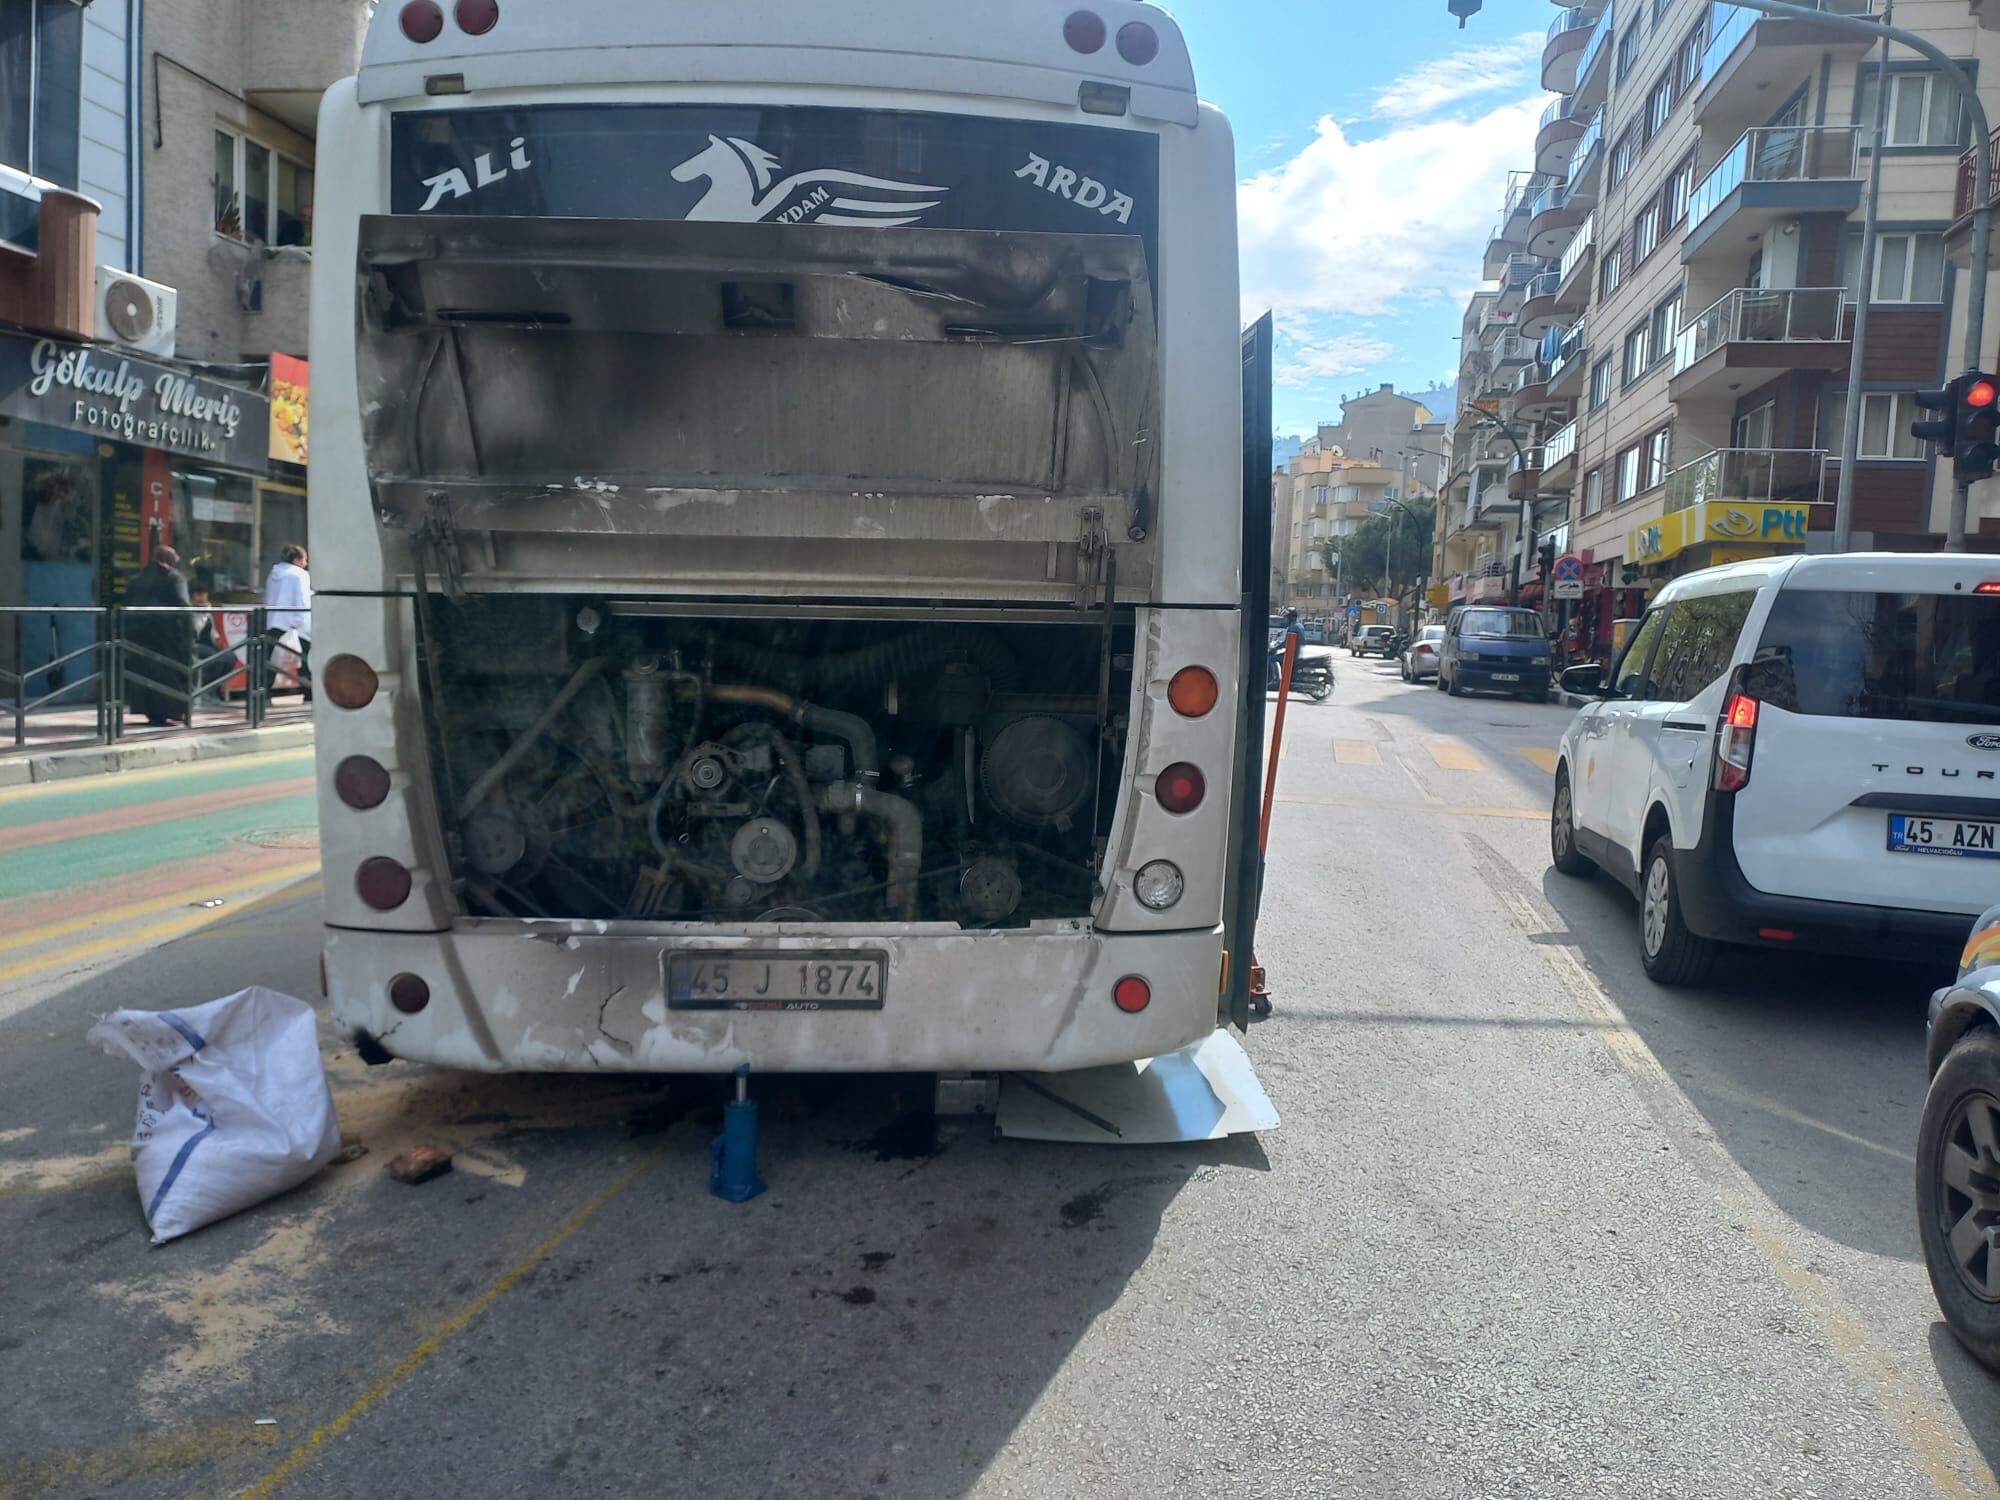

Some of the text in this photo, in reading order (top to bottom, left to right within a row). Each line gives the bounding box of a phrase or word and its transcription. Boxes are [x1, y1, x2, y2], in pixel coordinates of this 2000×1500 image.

[1014, 151, 1134, 225] ARDA
[31, 339, 241, 438] Gökalp Meriç
[1762, 508, 1807, 537] Ptt
[1872, 763, 1995, 779] TOUR
[1906, 819, 1994, 849] 45 AZN
[692, 963, 875, 996] 45 J 1874
[786, 1001, 819, 1011] AUTO
